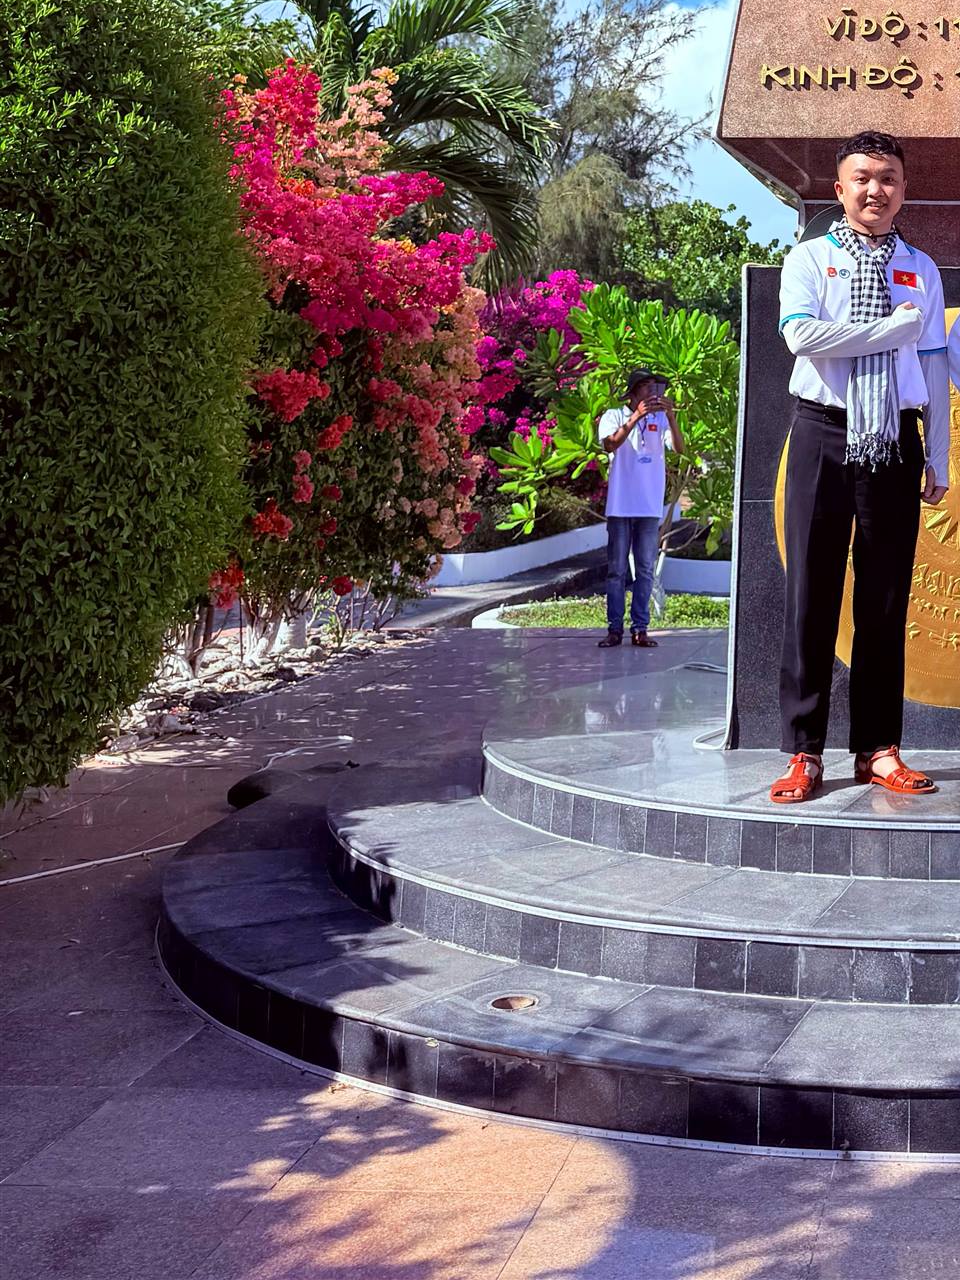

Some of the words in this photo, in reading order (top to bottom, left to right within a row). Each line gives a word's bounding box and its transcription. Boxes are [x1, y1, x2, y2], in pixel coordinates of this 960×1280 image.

[859, 7, 905, 42] ĐỘ
[761, 63, 851, 86] KINH
[862, 55, 918, 94] ĐỘ
